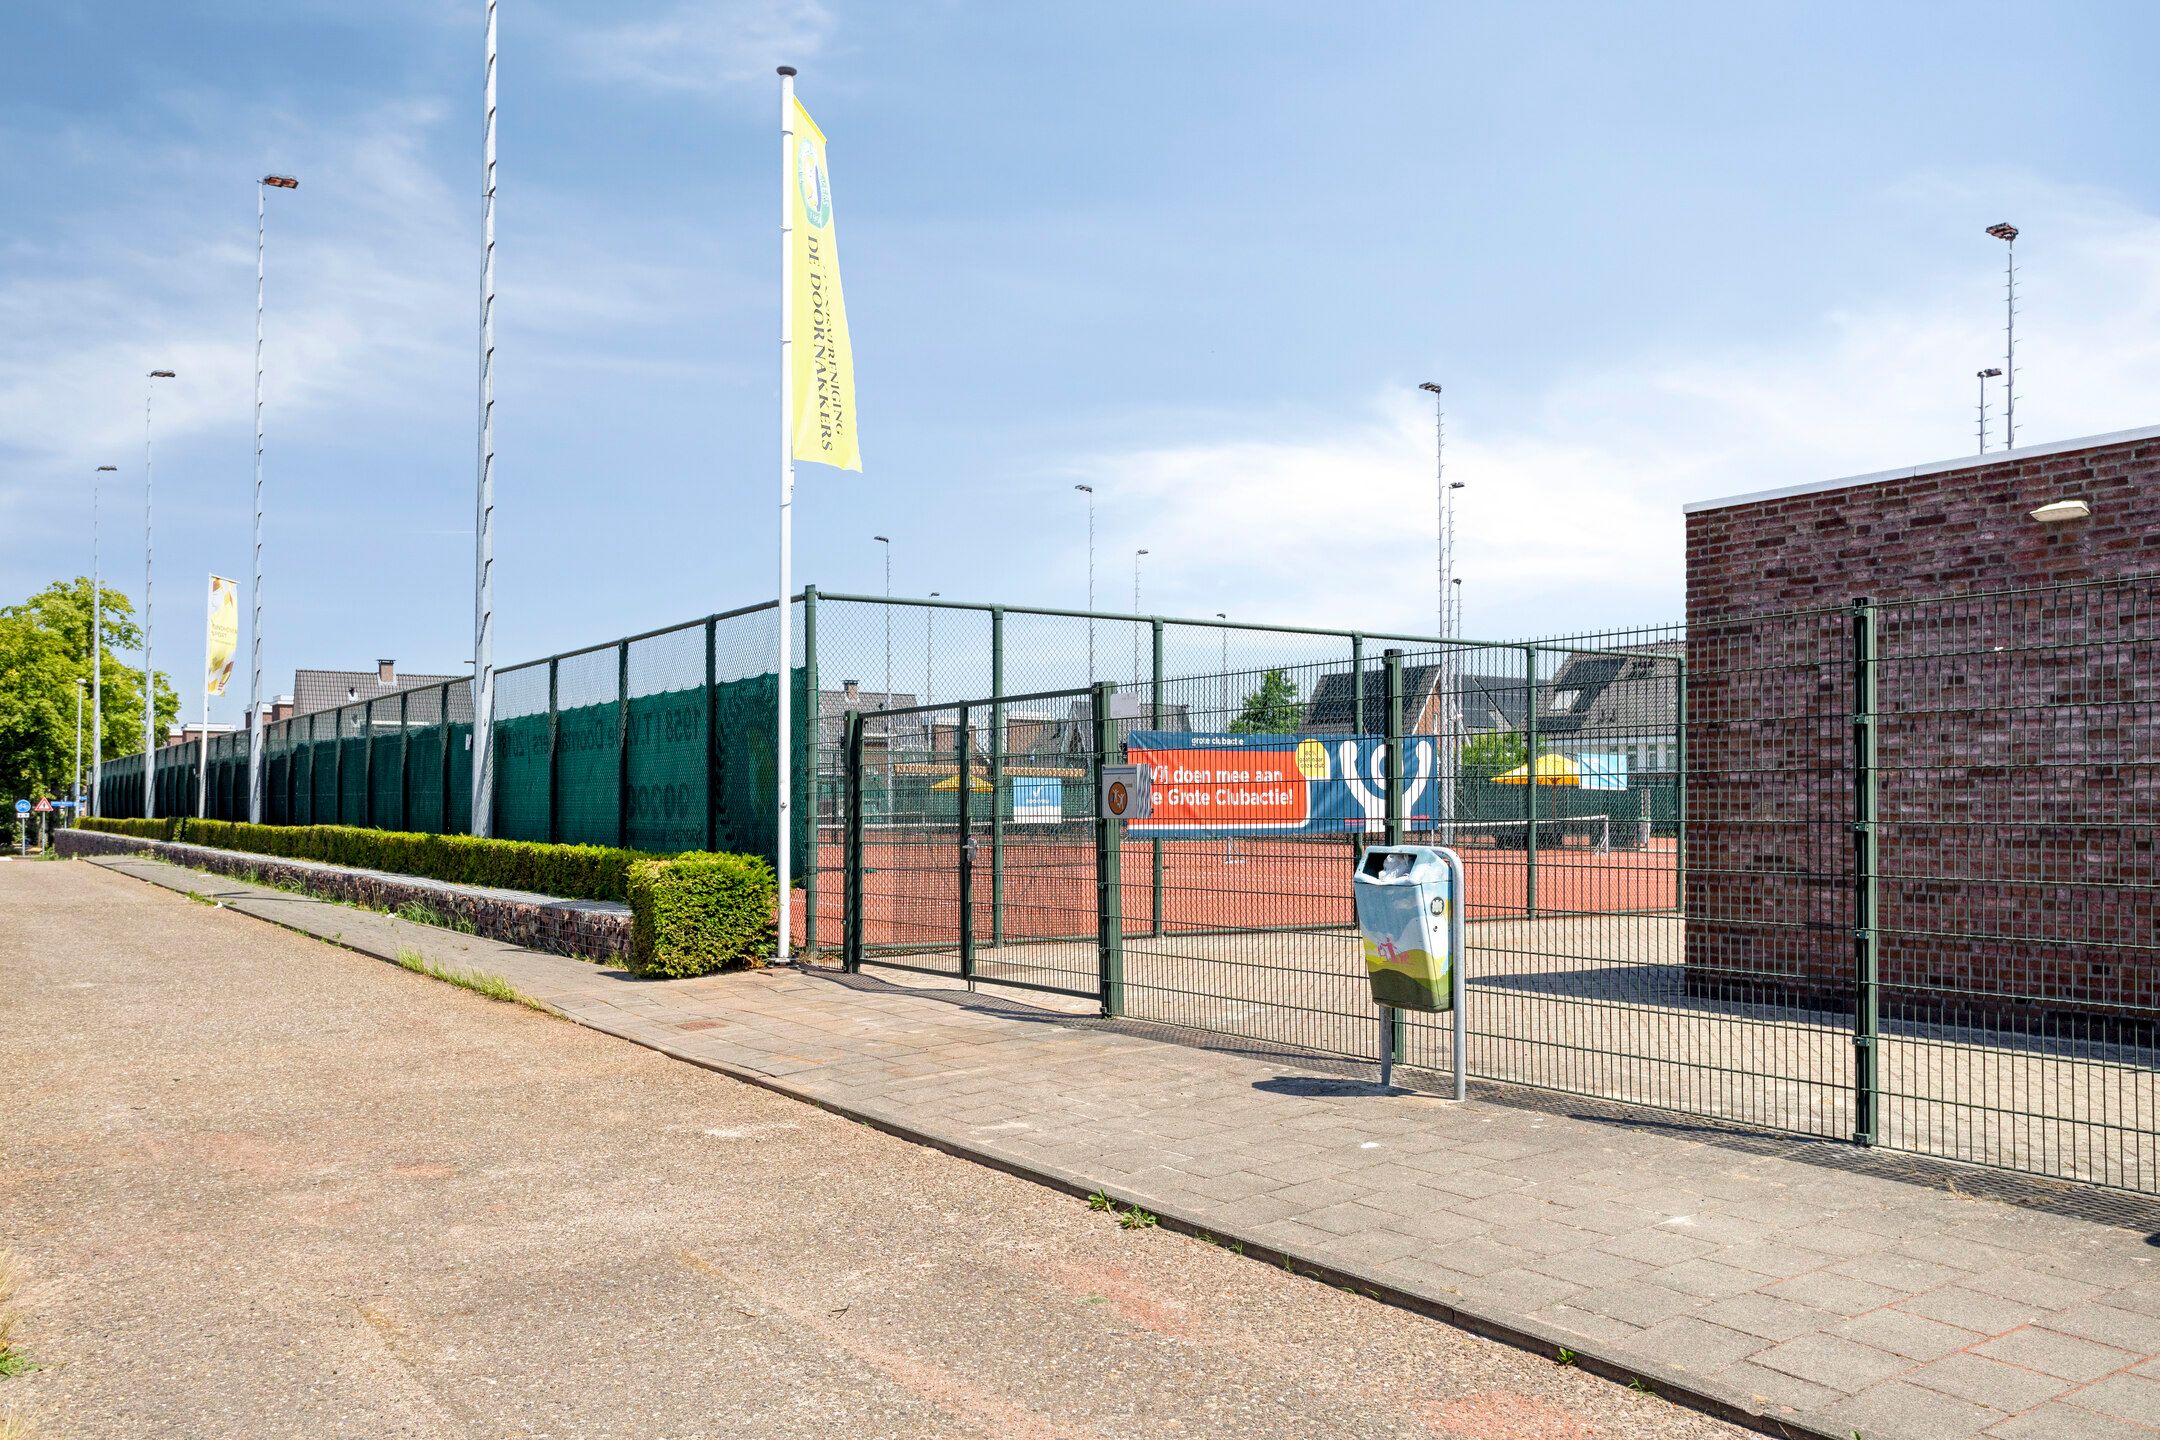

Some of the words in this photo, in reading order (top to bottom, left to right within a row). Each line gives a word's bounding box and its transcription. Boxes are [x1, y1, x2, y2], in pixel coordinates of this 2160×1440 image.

[807, 235, 820, 266] DE
[810, 272, 834, 451] DOORNAKKERS
[1211, 736, 1244, 746] clubacte
[1173, 766, 1211, 783] doen
[1216, 769, 1250, 782] mee
[1255, 769, 1283, 783] aan
[1168, 788, 1211, 805] Grote
[1216, 788, 1293, 805] Clubactie!
